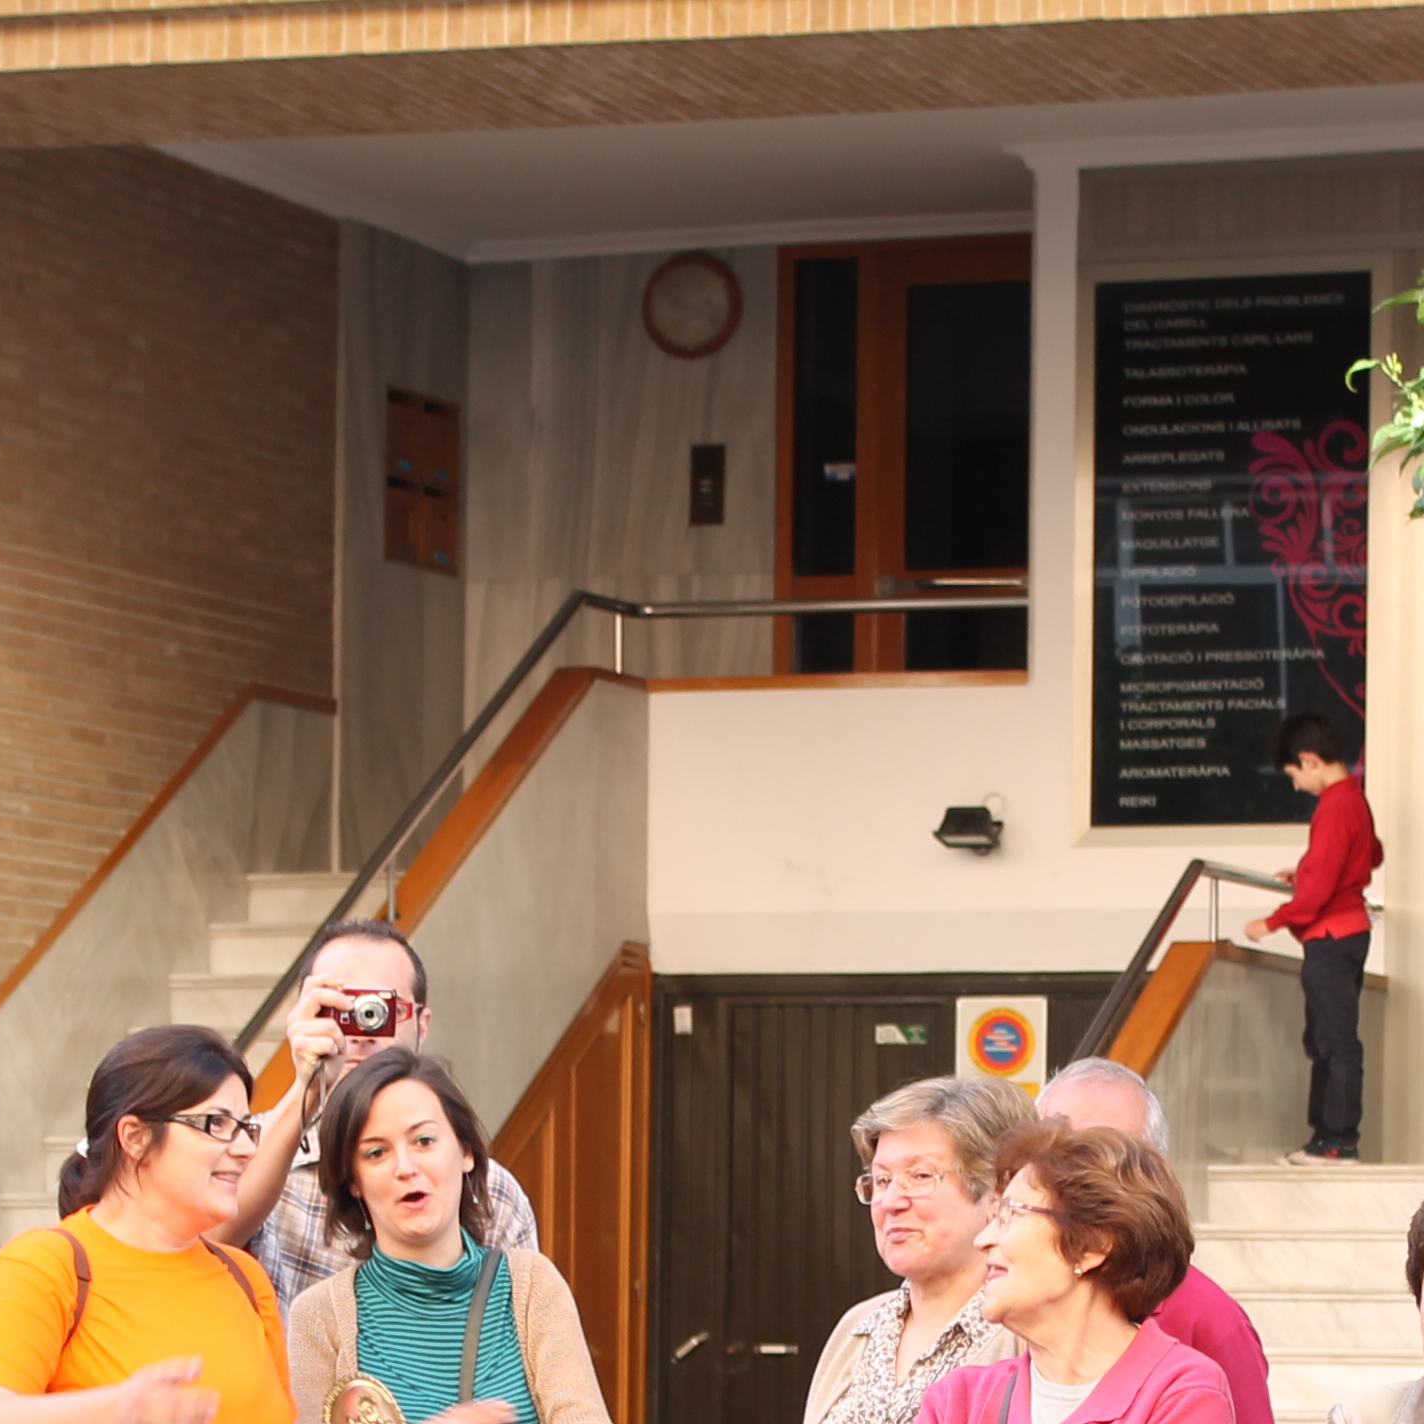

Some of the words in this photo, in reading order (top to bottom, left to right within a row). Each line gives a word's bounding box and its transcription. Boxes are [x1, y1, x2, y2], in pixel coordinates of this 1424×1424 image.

[1154, 317, 1208, 330] CABELL
[1124, 335, 1228, 350] TRACTAMENTS
[1122, 394, 1173, 408] FORMA
[1184, 391, 1235, 406] COLOR
[1122, 421, 1226, 437] ONDULACIONS
[1235, 417, 1302, 432] ALLISATS
[1122, 449, 1226, 465] ARREPLEGATS
[1122, 478, 1213, 494] EXTENSIONS
[1121, 508, 1184, 522] MONYOS
[1188, 506, 1250, 520] FALLERA
[1121, 536, 1220, 551] MAQUILLATGE
[1120, 564, 1197, 580] DEPILACIÓ
[1120, 592, 1235, 608] FOTODEPILACIÓ
[1120, 622, 1219, 637] FOTOTERÀPIA
[1120, 650, 1194, 666] CAVITACIÓ
[1205, 647, 1325, 664] PRESSOTERÀPIA
[1120, 676, 1265, 694] MICROPIGMENTACIÓ
[1120, 699, 1224, 714] TRACTAMENTS
[1228, 697, 1287, 711] FACIALS
[1128, 717, 1216, 731] CORPORALS
[1120, 736, 1206, 750] MASSATGES
[1119, 765, 1230, 780] AROMATERÀPIA
[1119, 795, 1157, 808] REIKI
